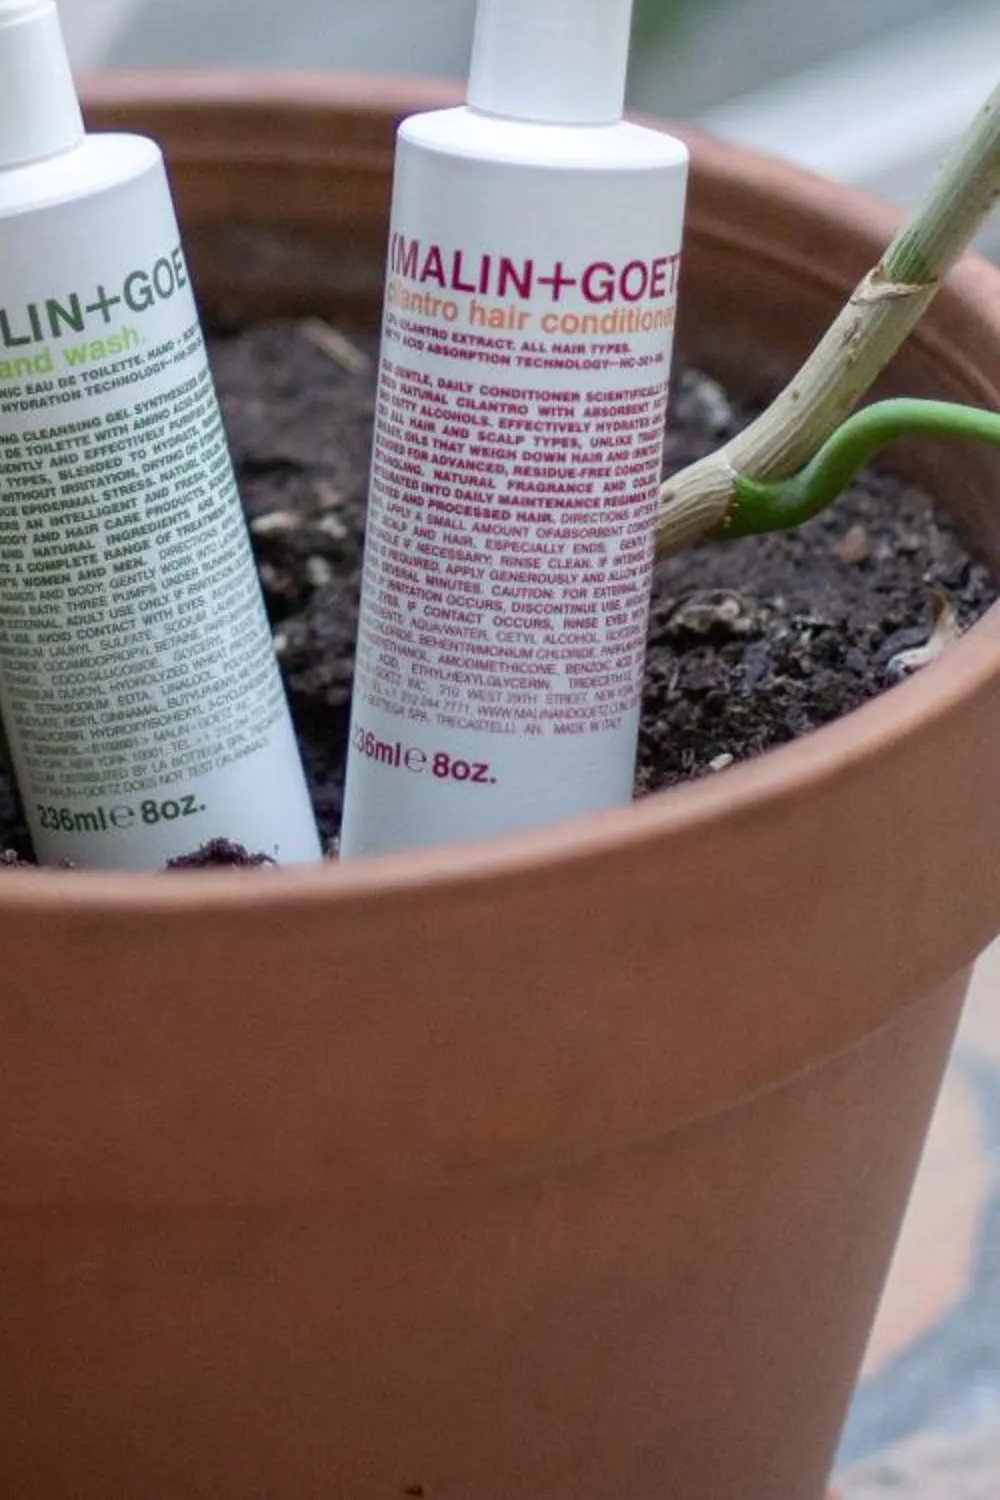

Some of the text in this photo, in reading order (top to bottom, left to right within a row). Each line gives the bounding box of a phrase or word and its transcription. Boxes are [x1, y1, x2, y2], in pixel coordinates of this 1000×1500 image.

[466, 298, 532, 331] hair
[426, 342, 512, 365] ABSORPTION
[520, 341, 546, 352] ALL
[551, 343, 587, 354] HAIR
[24, 380, 55, 395] EAU
[57, 374, 77, 388] DE
[437, 377, 582, 401] DAILY CONDITIONER
[1, 388, 81, 413] HYDRATION
[456, 396, 575, 416] CILANTRO WITH
[3, 447, 23, 458] DE
[26, 433, 92, 455] TOILETTE
[94, 422, 130, 441] WITH
[131, 406, 170, 430] AMINO
[21, 406, 132, 441] CLEANSING GEL
[409, 416, 435, 432] HAIR
[442, 424, 470, 438] AND
[476, 430, 525, 445] SCALP
[589, 434, 633, 446] UNLIKE
[498, 417, 591, 431] EFFECTIVELY
[49, 451, 80, 466] AND
[82, 423, 167, 459] EFFECTIVELY
[407, 446, 428, 461] FOR
[432, 437, 464, 453] THAT
[468, 444, 517, 459] WEIGH
[522, 450, 567, 462] DOWN
[571, 451, 604, 462] HAIR
[607, 449, 630, 461] AND
[57, 447, 147, 480] BLENDED TO
[432, 468, 496, 487] NATURAL
[506, 479, 594, 492] FRAGRANCE
[603, 479, 626, 491] AND
[1, 486, 57, 501] WITHOUT
[20, 492, 99, 515] EPIDERMAL
[402, 490, 511, 519] AND PROCESSED
[421, 480, 601, 507] INTO DAILY MAINTENANCE
[24, 484, 171, 529] AN INTELLIGENT AND
[31, 510, 142, 542] AND HAIR CARE
[32, 507, 191, 557] NATURAL INGREDIENTS
[426, 512, 531, 536] SMALL AMOUNT
[26, 529, 176, 572] COMPLETE RANGE OF
[412, 524, 564, 552] AND ESPECIALLY
[444, 562, 606, 582] APPLY GENEROUSLY AND
[499, 554, 543, 567] RINSE
[21, 565, 107, 586] WOMEN AND
[38, 588, 65, 600] AND
[561, 587, 589, 598] FOR
[423, 603, 599, 628] CONTACT RINSE
[510, 601, 599, 613] DISCONTINUE
[75, 606, 174, 639] CONTACT WITH
[430, 749, 499, 785] 8oz.
[35, 801, 109, 832] 236ml
[137, 784, 208, 826] 8oz.
